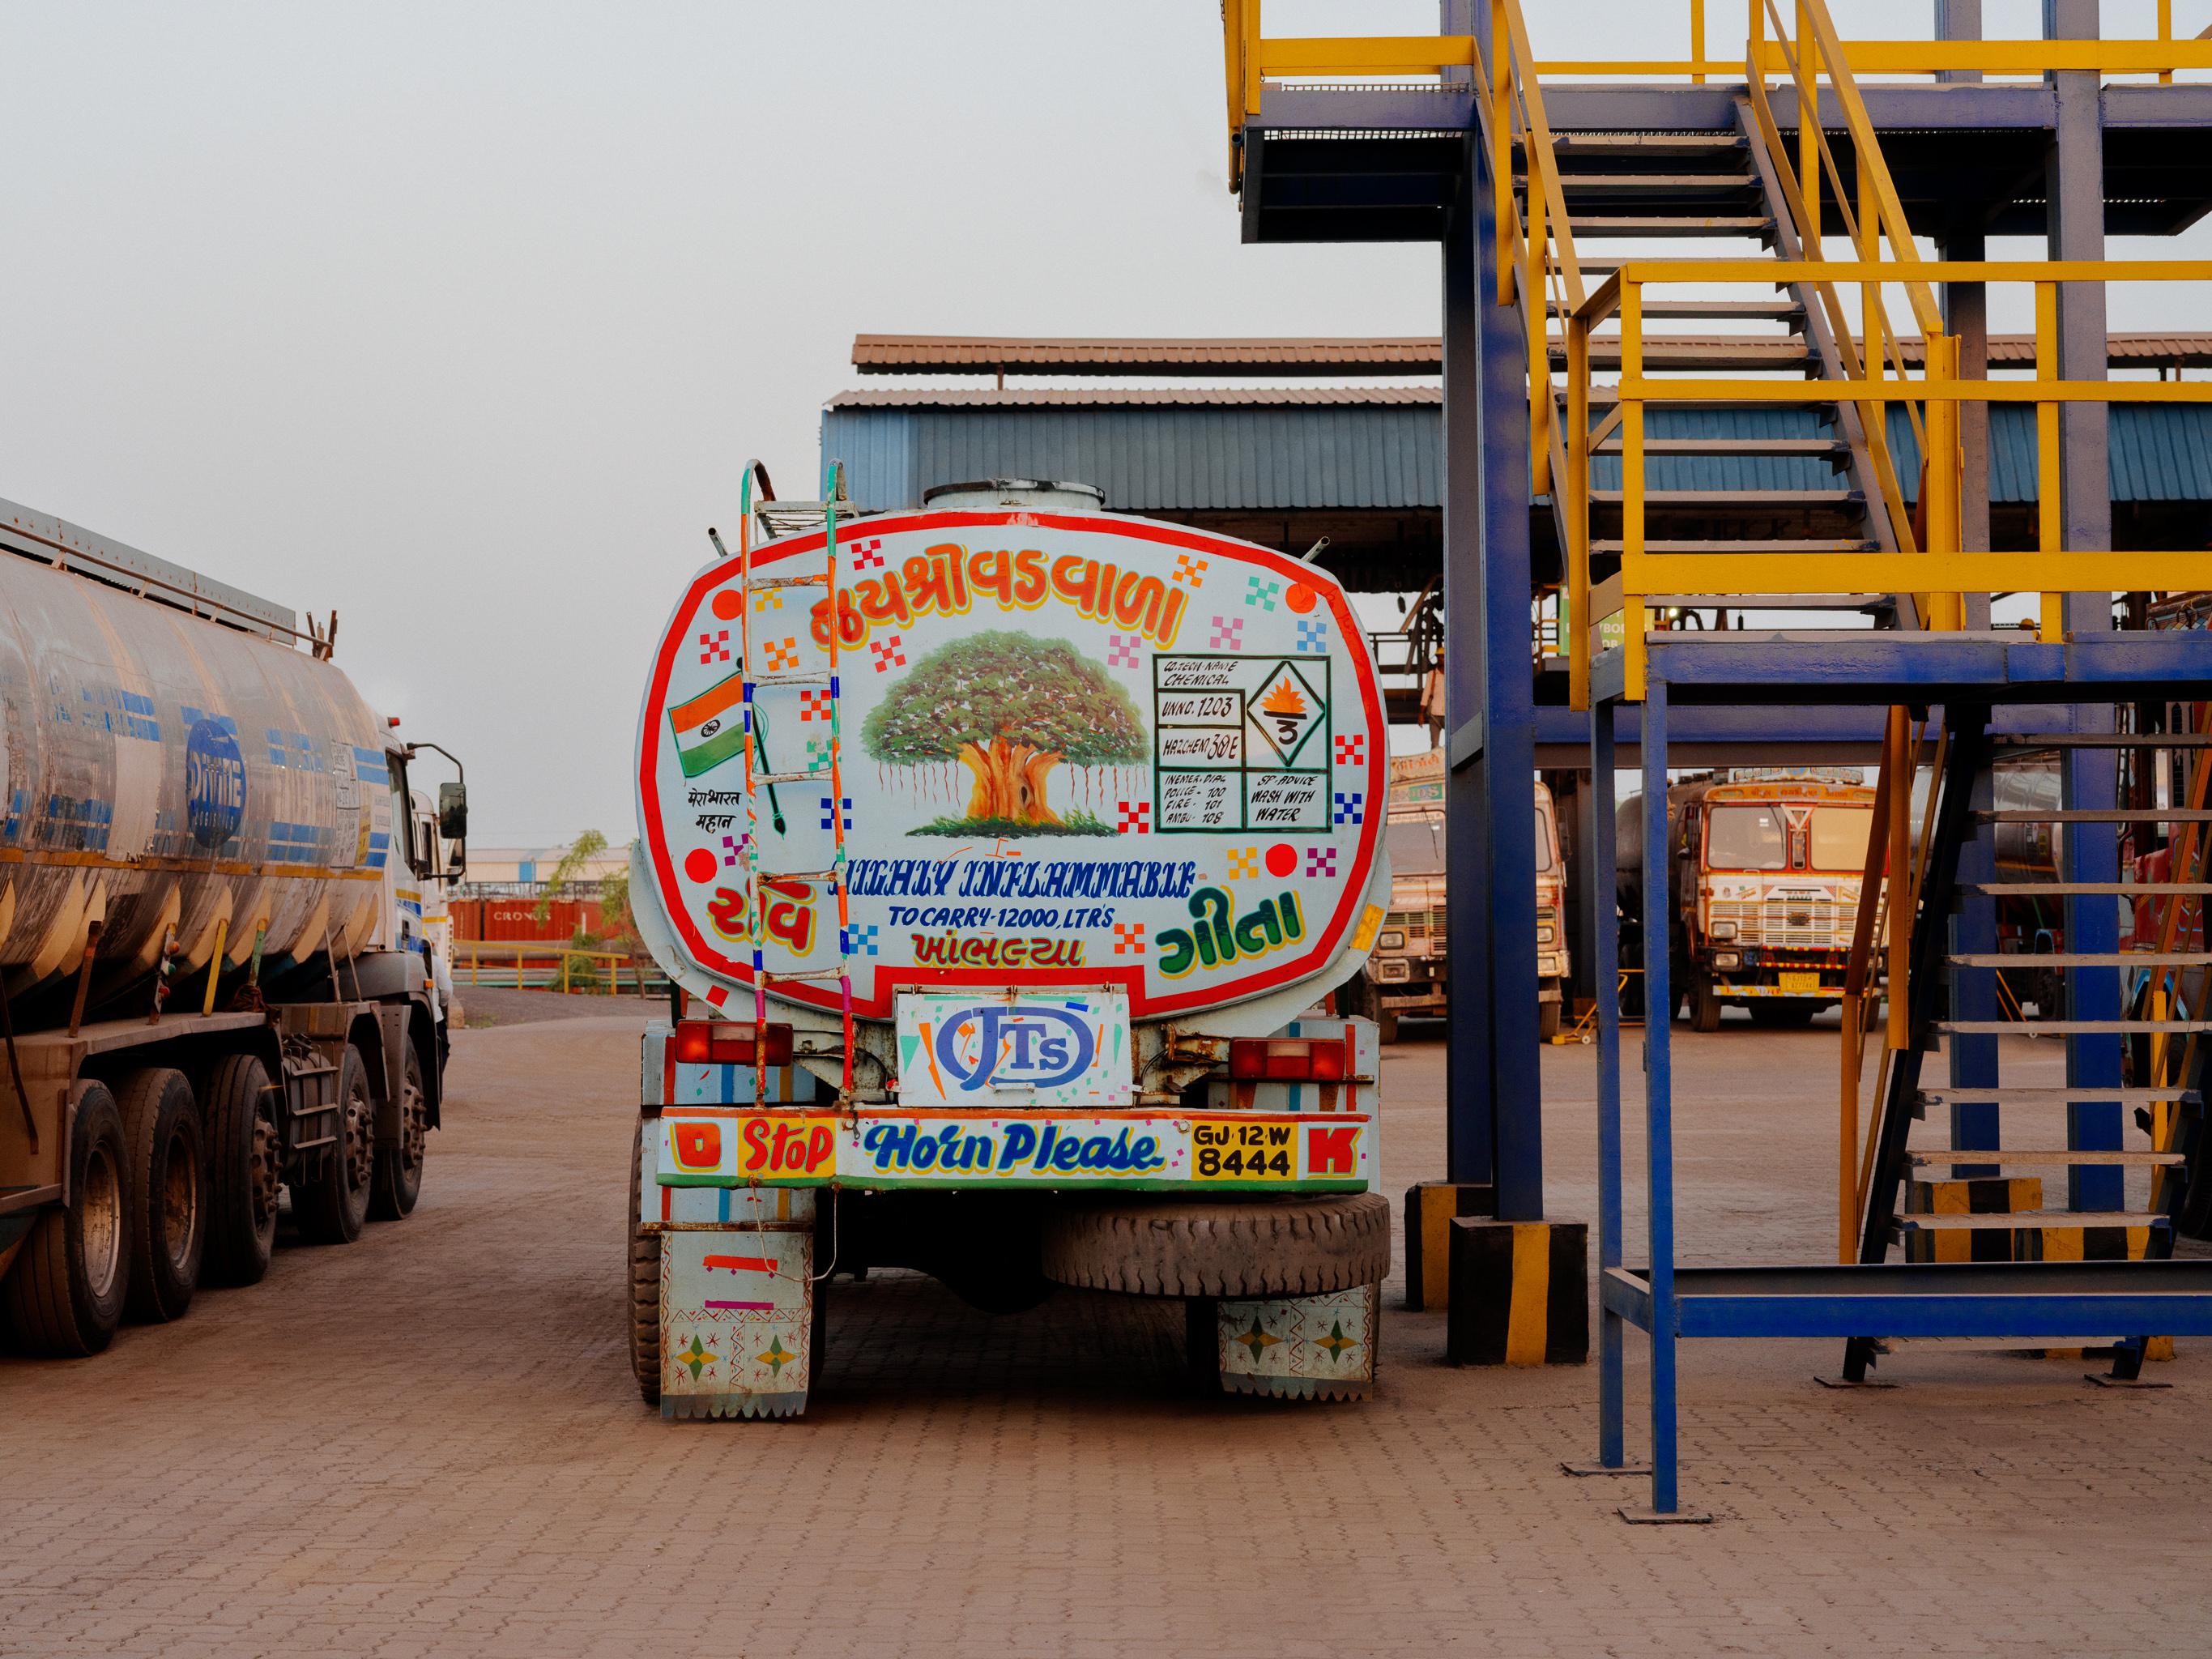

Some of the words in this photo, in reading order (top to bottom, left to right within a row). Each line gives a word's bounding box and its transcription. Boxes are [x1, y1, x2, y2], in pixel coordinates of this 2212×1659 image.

[1164, 673, 1229, 687] CHEMICAL
[1197, 697, 1234, 718] 1203
[1276, 719, 1298, 745] 3
[1163, 737, 1210, 756] HAZCHEM
[1207, 787, 1227, 798] 100
[1251, 789, 1284, 804] WASH
[1283, 790, 1316, 804] WITH
[1204, 799, 1224, 811] 101
[1255, 807, 1302, 822] WATER
[695, 814, 737, 834] महान
[1202, 811, 1225, 825] 108
[1155, 886, 1302, 975] ગીતા
[863, 1123, 993, 1171] Horn
[999, 1122, 1165, 1173] Please
[1198, 1148, 1291, 1176] 8444
